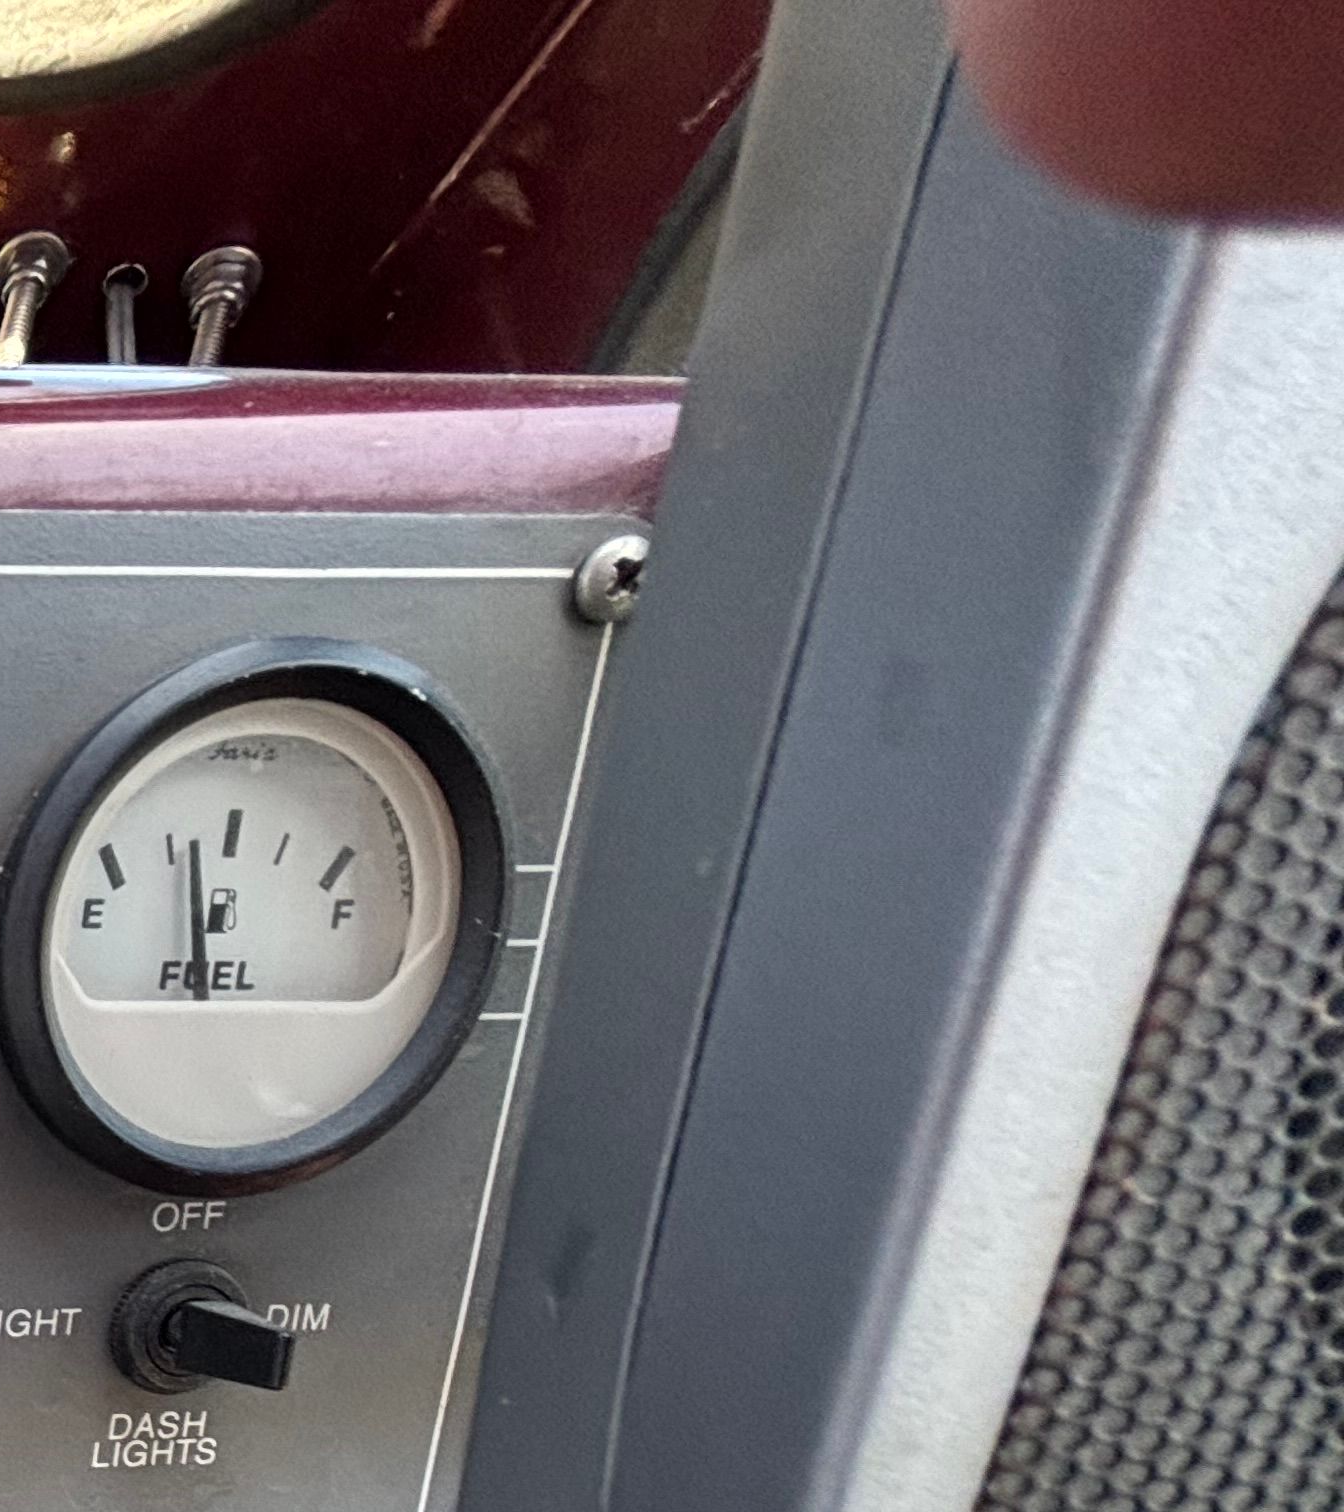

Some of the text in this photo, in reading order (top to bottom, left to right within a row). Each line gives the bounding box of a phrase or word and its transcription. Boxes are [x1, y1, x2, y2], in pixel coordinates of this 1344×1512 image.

[80, 898, 106, 929] E
[331, 899, 355, 930] F
[151, 1201, 228, 1232] OFF
[266, 1303, 332, 1331] DIM
[108, 1411, 208, 1441] DASH
[91, 1438, 218, 1469] LIGHTS
